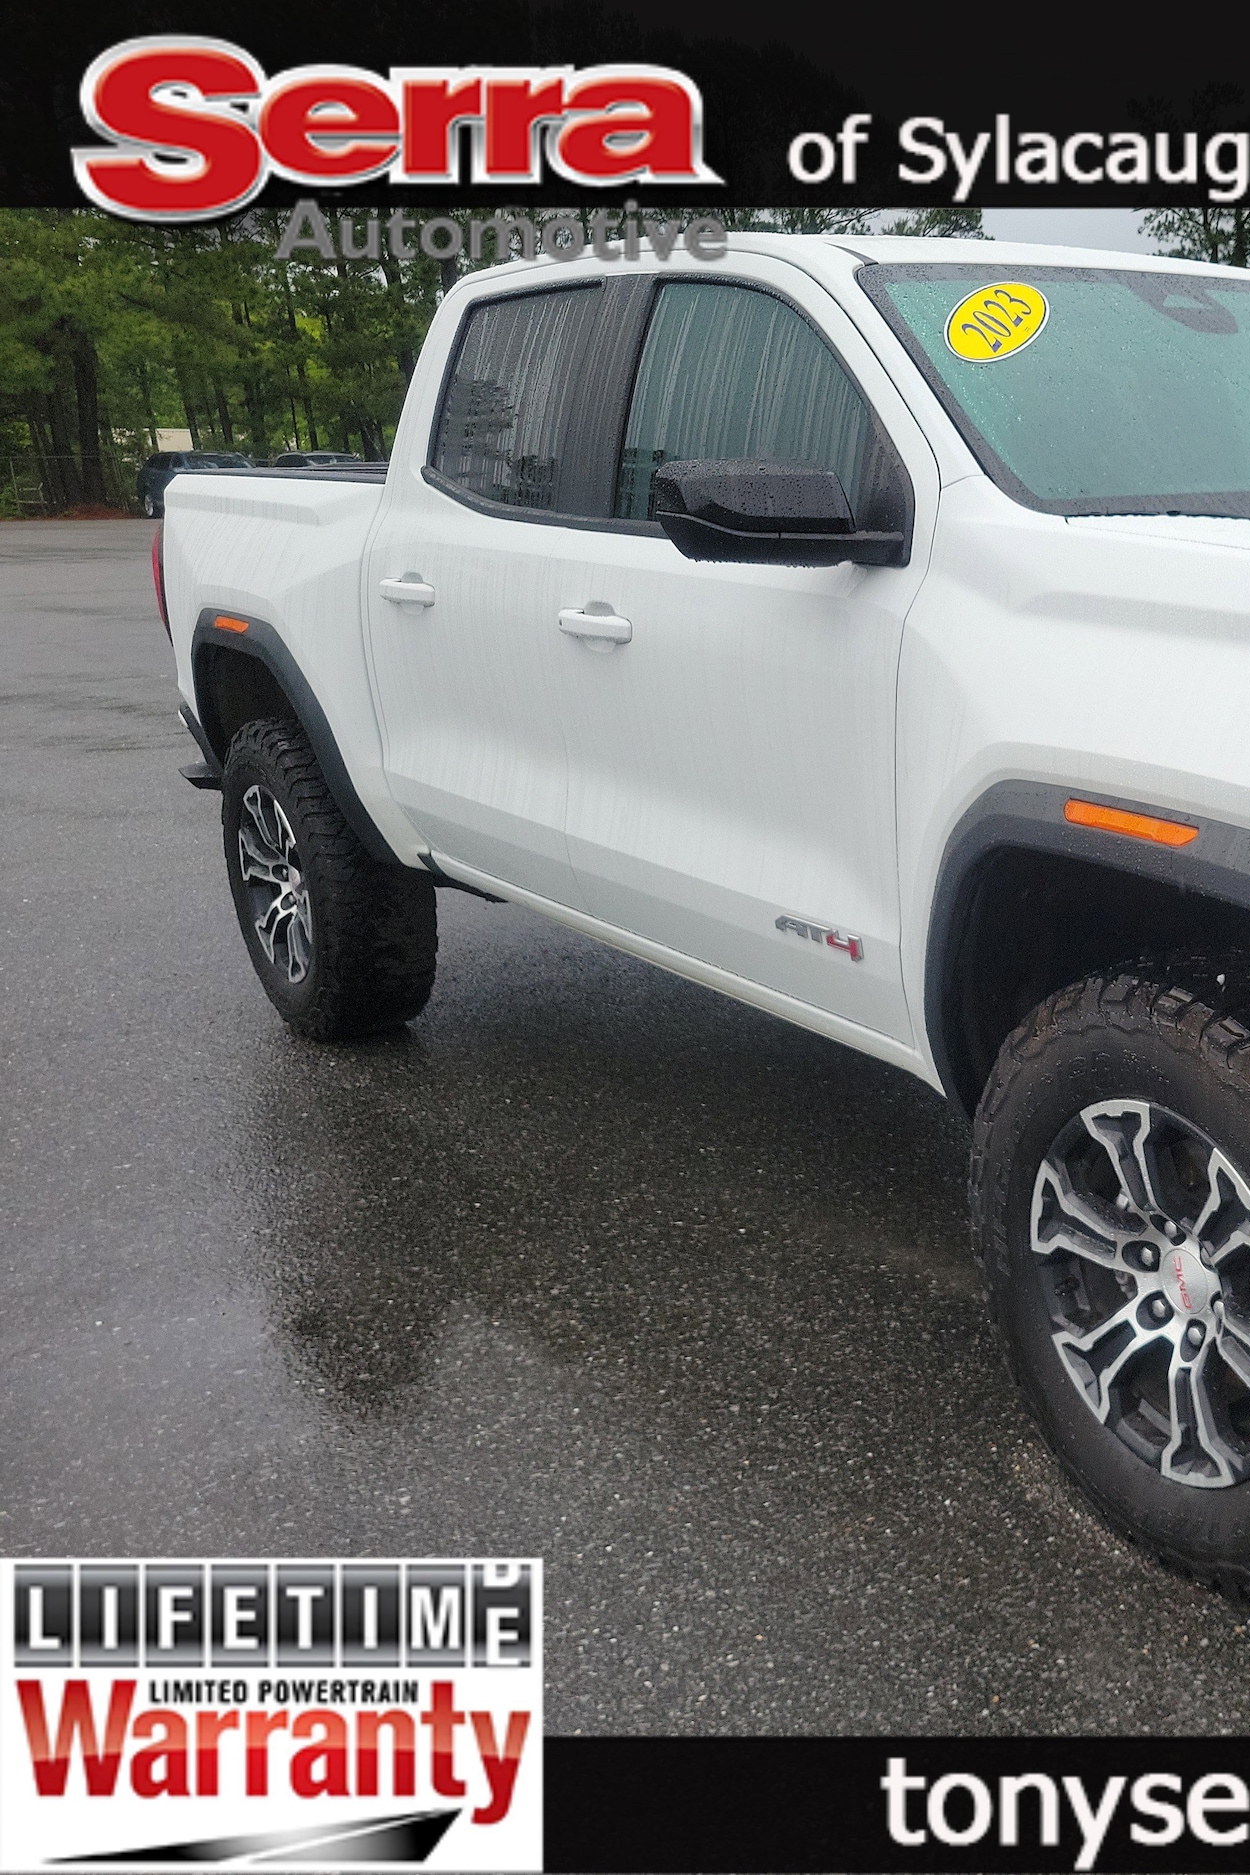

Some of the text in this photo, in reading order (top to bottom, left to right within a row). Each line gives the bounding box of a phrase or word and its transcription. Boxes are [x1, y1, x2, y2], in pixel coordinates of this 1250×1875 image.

[961, 289, 1032, 353] 2023
[775, 914, 864, 963] AT4
[1172, 1255, 1193, 1310] GMC
